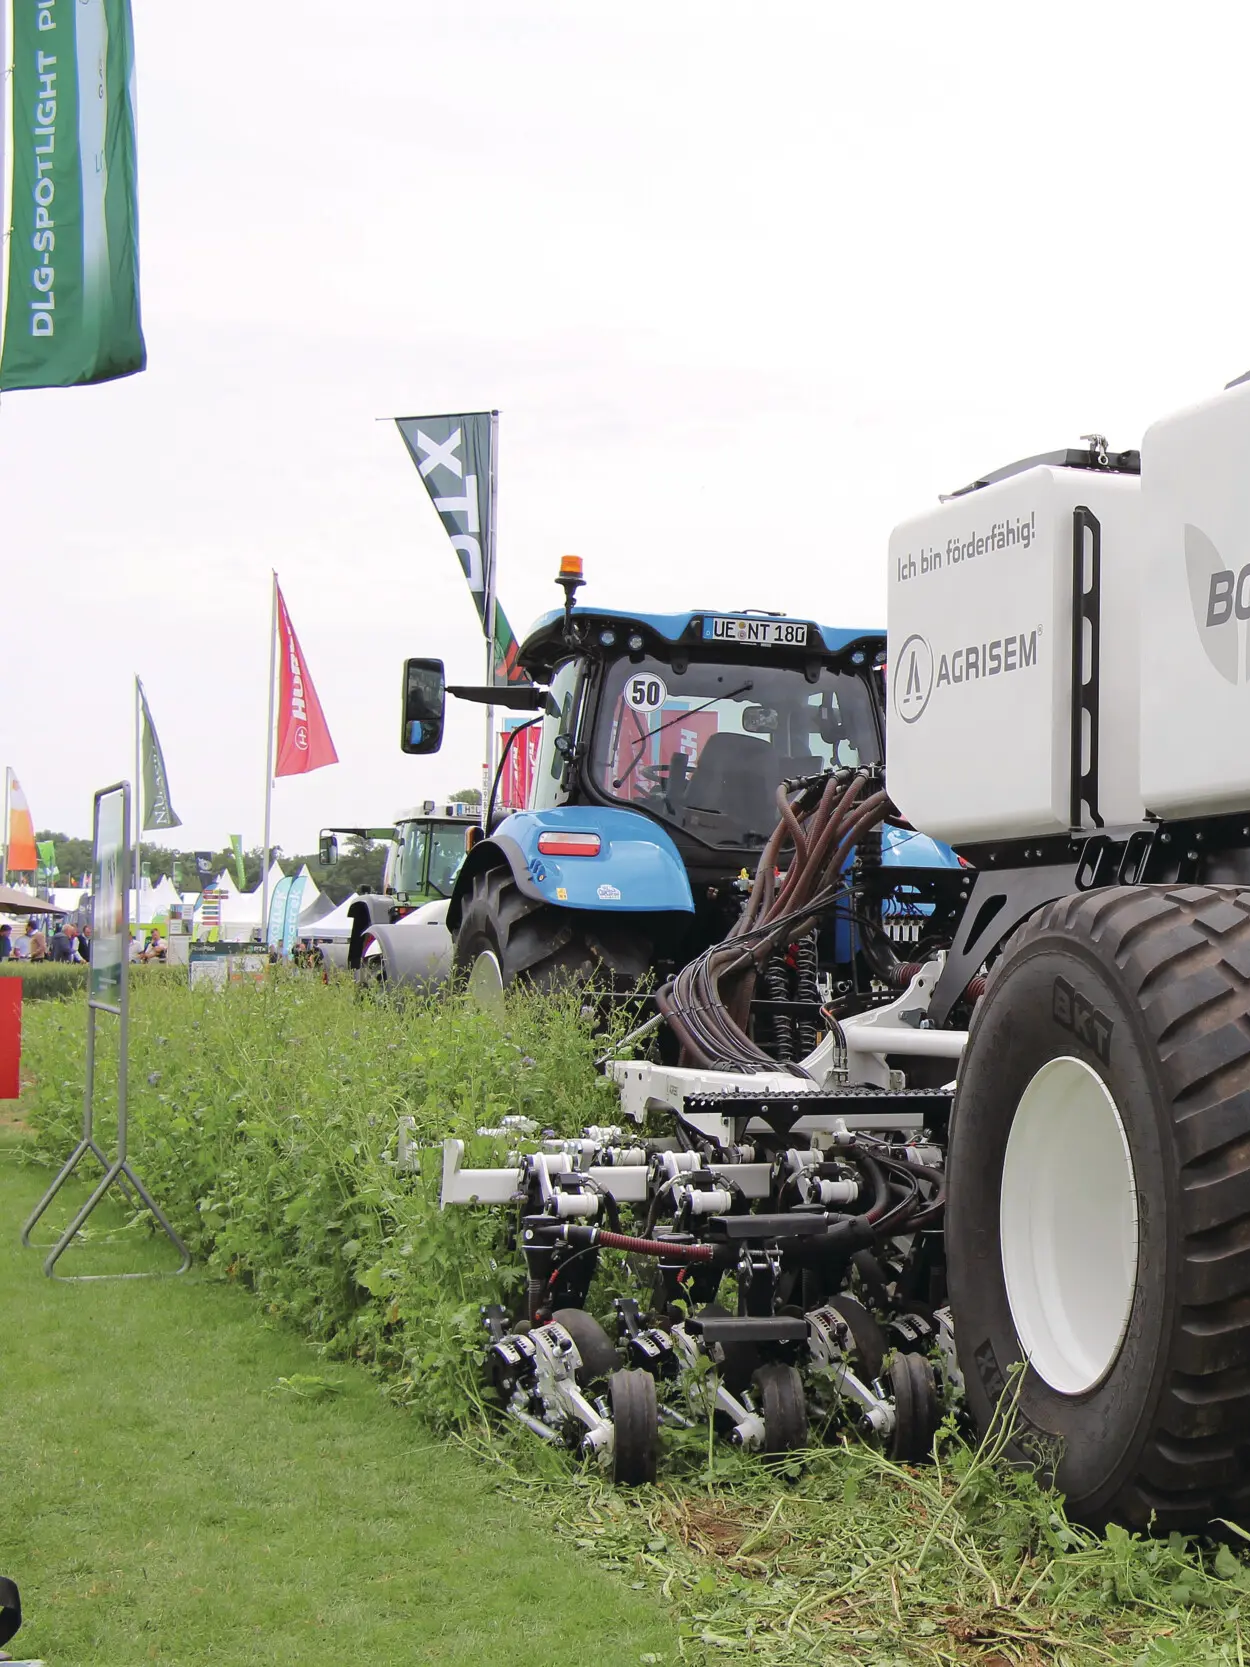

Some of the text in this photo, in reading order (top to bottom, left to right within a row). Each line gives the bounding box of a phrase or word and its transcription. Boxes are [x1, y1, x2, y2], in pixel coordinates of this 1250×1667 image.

[32, 51, 57, 337] DLG-SPOTLIGHT
[897, 511, 1035, 582] Ich bin förderfähig!
[714, 620, 736, 638] UE
[748, 623, 770, 641] NT
[774, 624, 806, 643] 180
[936, 631, 1037, 688] AGRISEM
[632, 680, 660, 706] 50
[1053, 978, 1113, 1065] BKT
